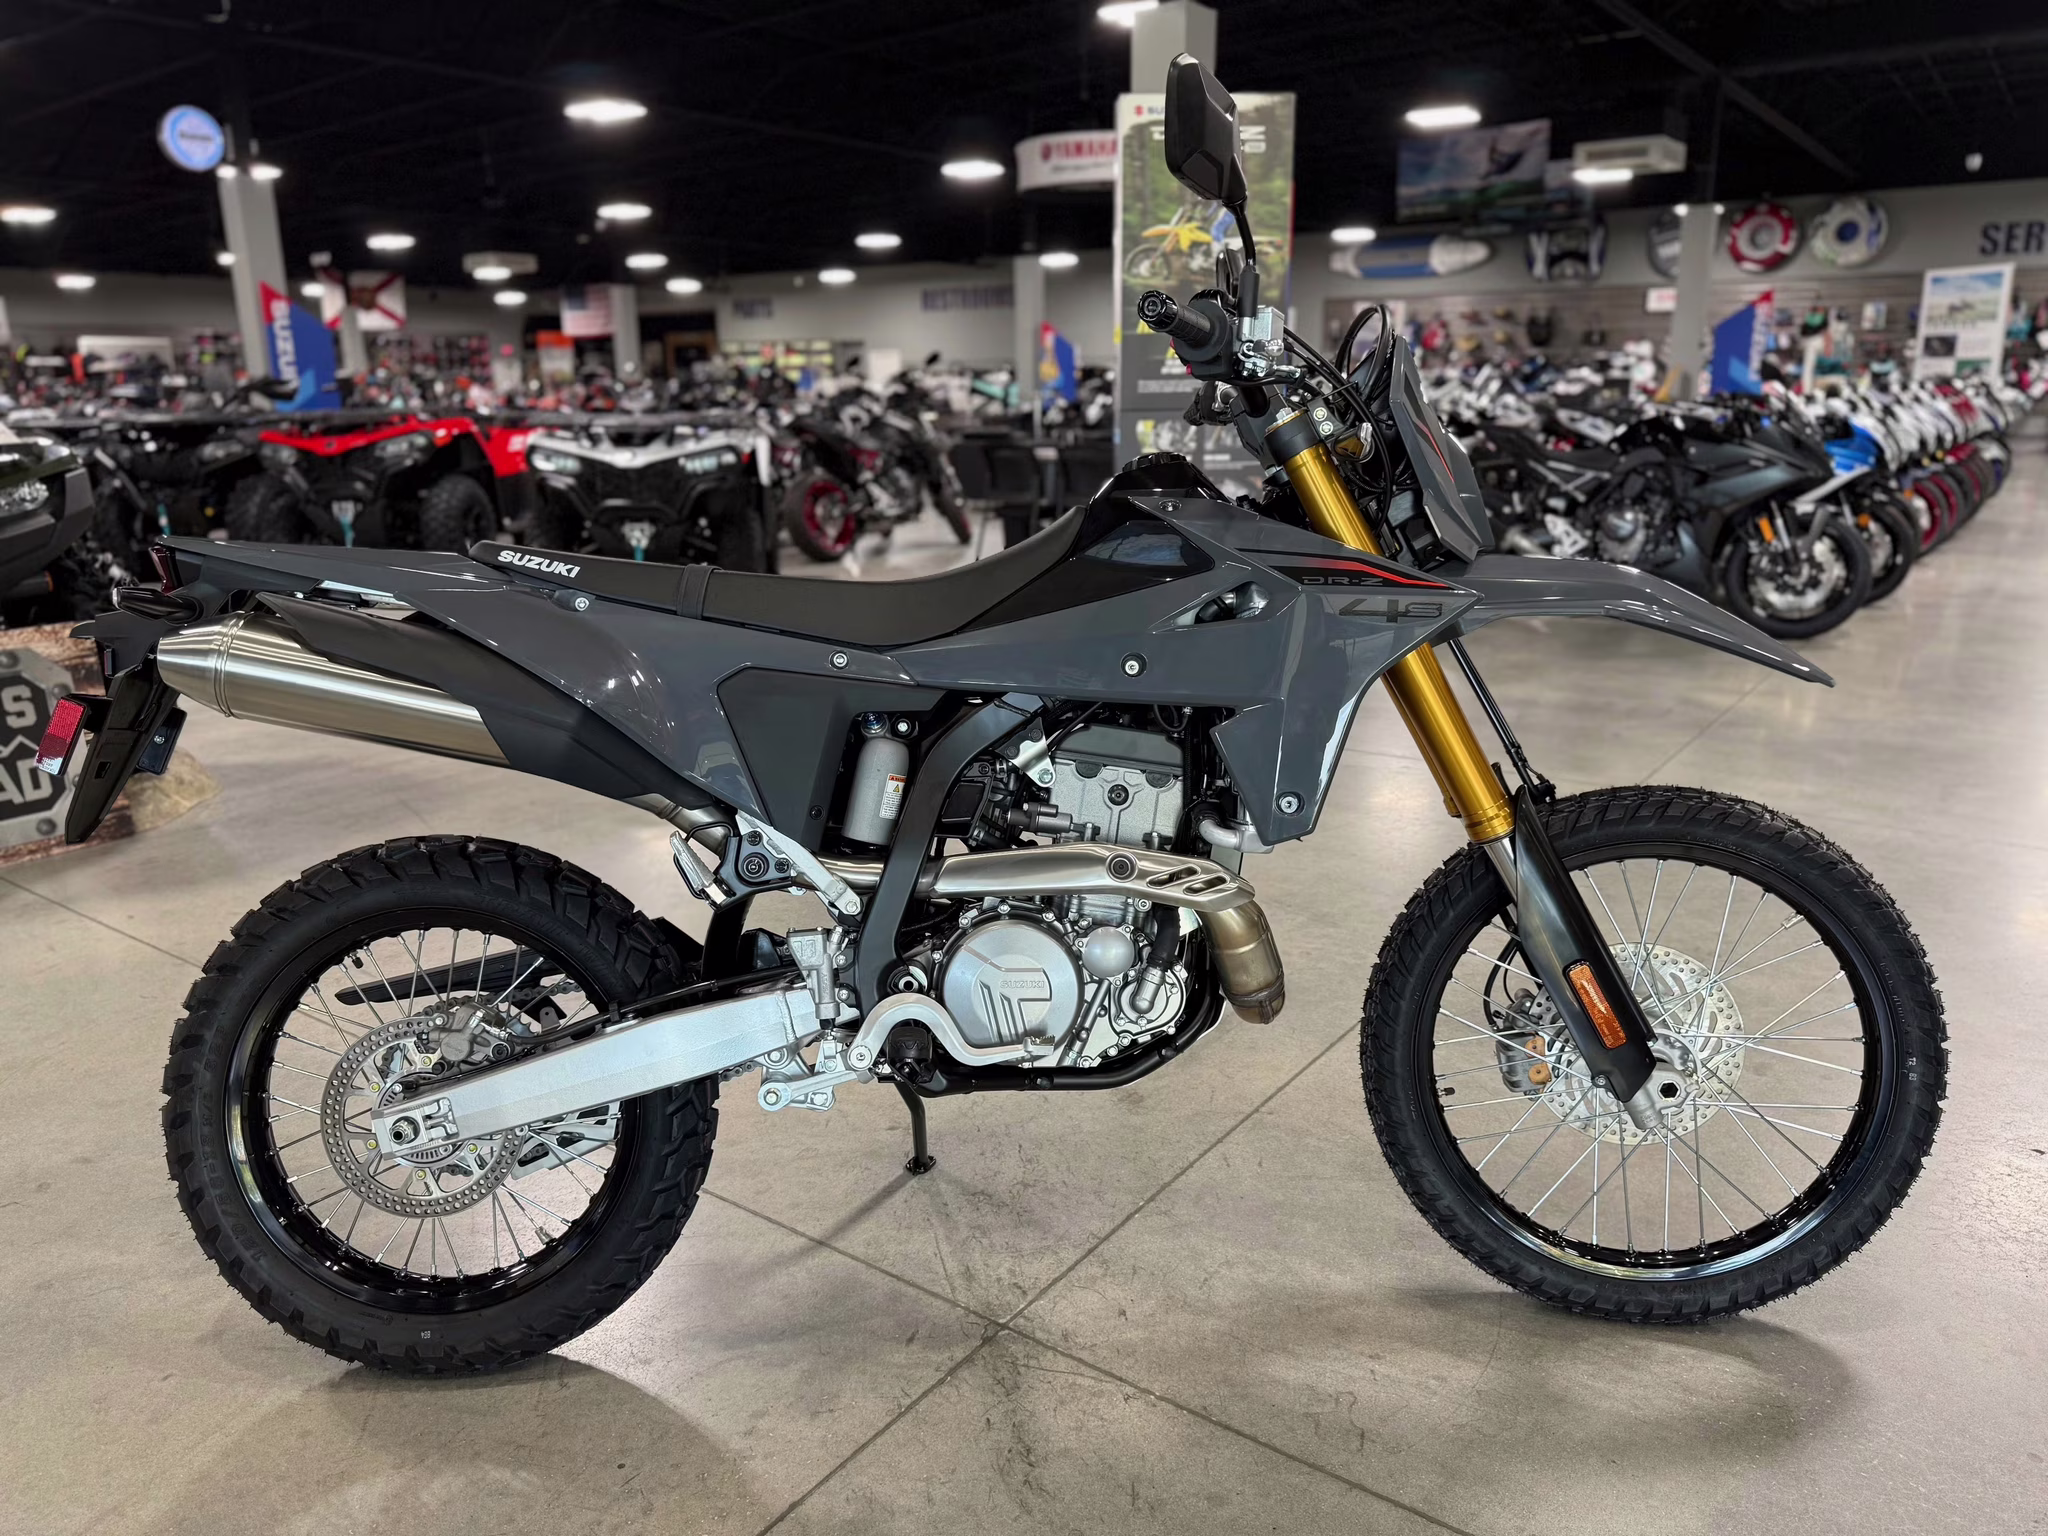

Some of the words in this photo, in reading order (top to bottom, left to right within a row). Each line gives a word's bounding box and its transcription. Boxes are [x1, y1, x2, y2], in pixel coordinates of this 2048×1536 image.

[497, 550, 581, 578] SUZUKI
[1302, 576, 1383, 586] DR-Z
[1000, 980, 1045, 989] SUZUKI
